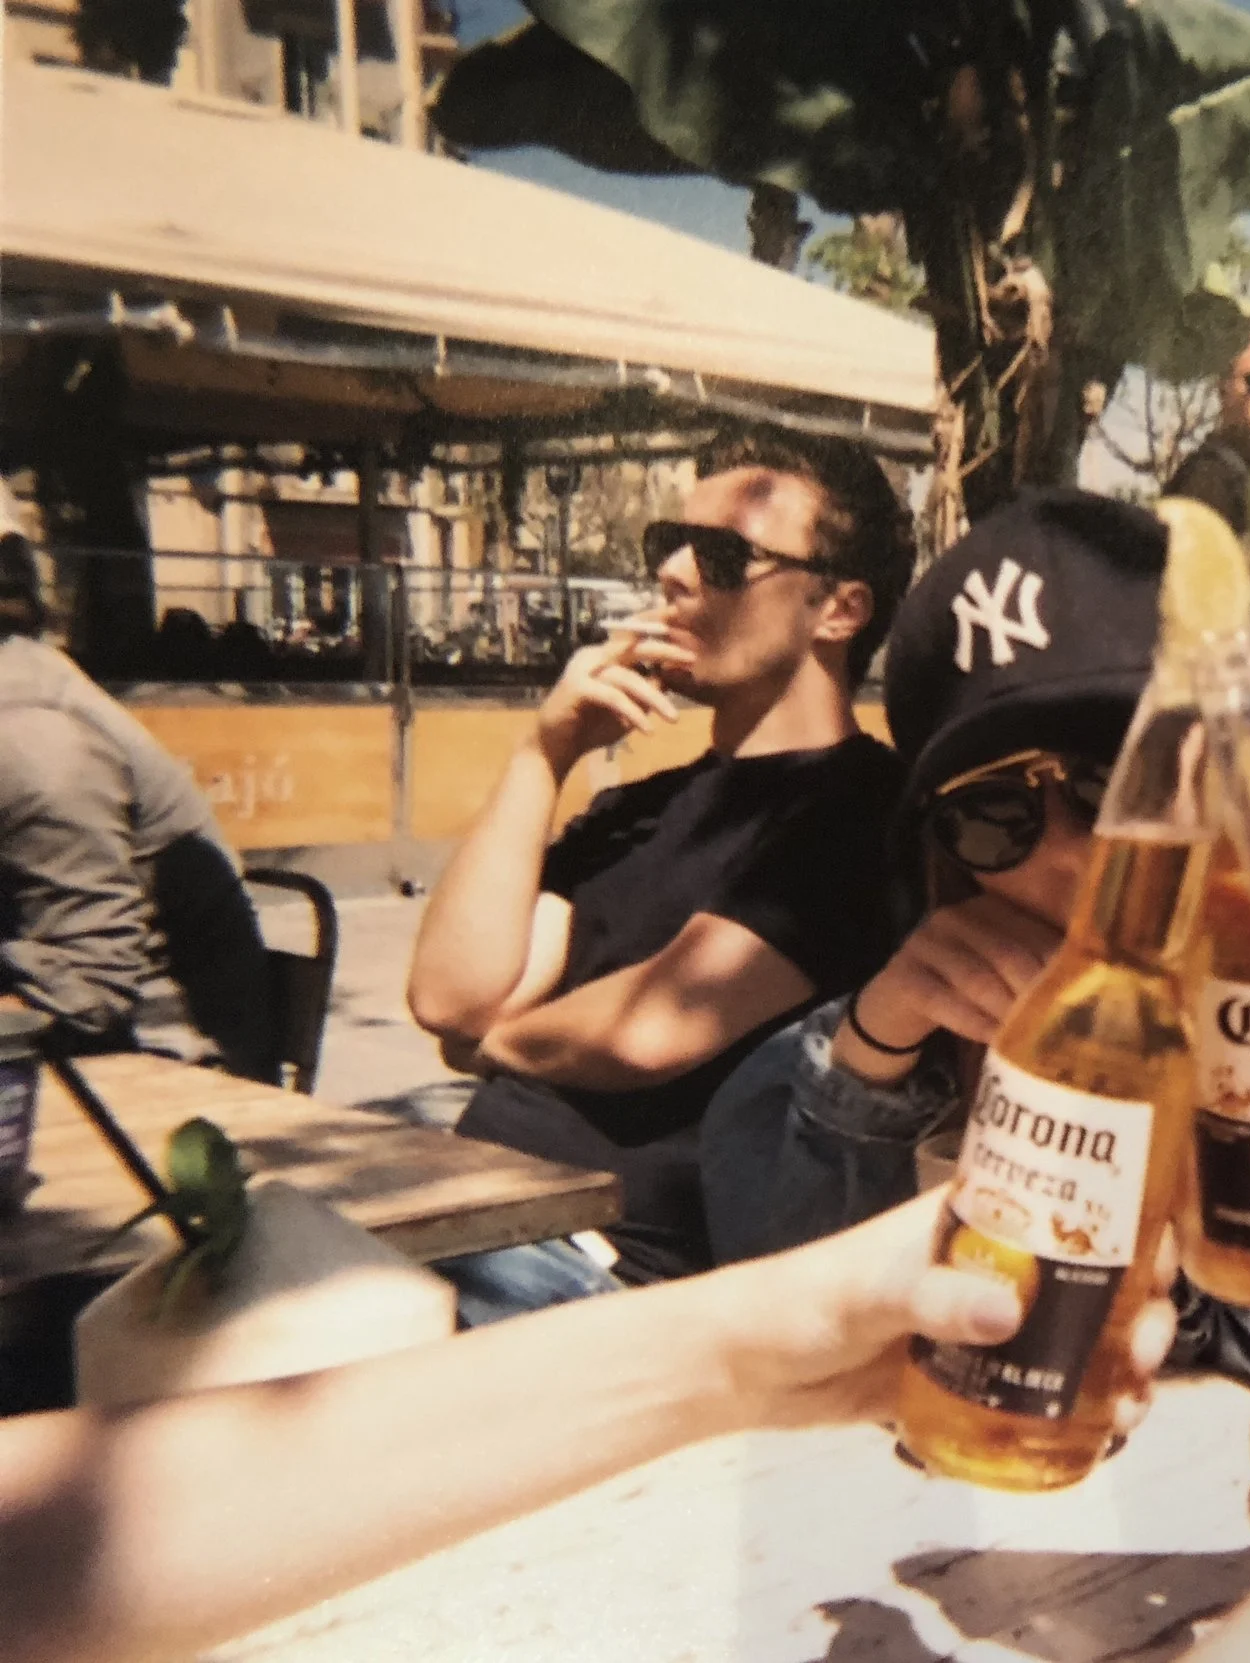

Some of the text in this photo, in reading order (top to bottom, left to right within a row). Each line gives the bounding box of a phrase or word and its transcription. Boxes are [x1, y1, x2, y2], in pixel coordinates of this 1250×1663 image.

[951, 557, 1050, 673] NY
[192, 754, 295, 820] ajó
[973, 1074, 1117, 1164] Corona
